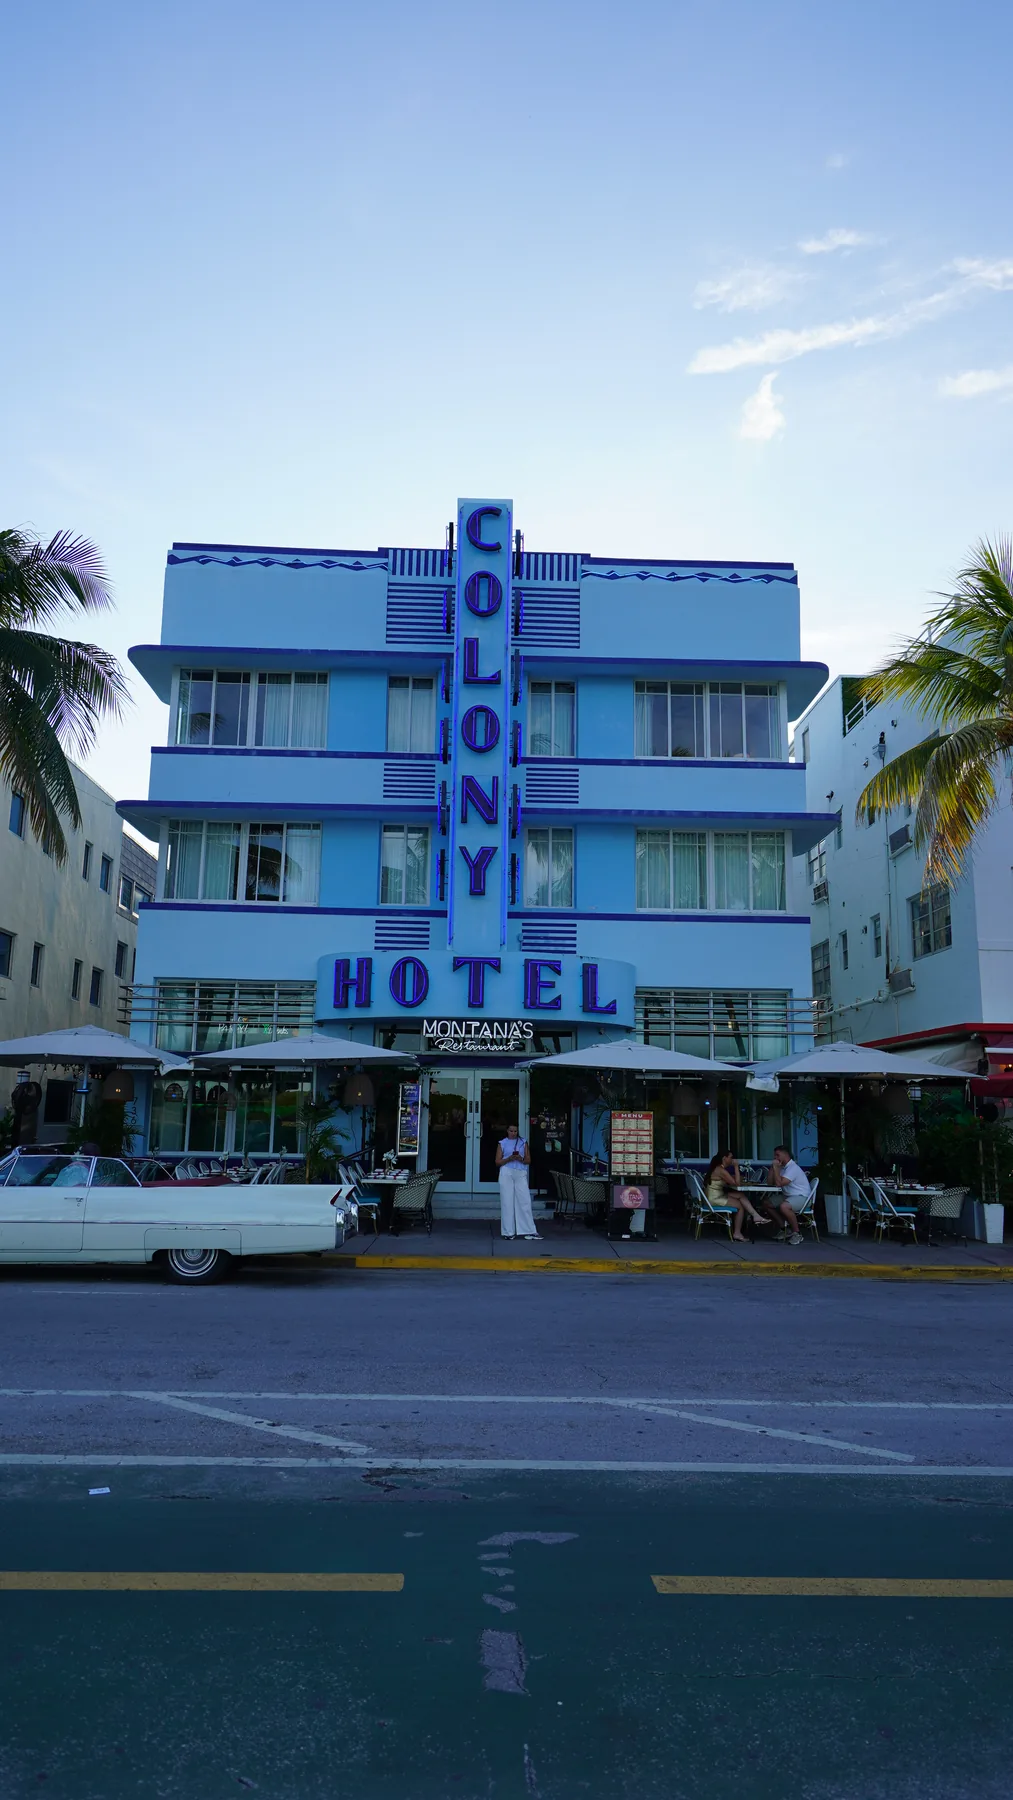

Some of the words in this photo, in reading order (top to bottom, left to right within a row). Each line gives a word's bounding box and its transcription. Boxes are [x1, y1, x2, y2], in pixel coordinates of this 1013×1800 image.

[460, 505, 502, 896] COLONY
[333, 956, 617, 1014] HOTEL
[422, 1019, 534, 1039] MONTANA'S
[434, 1037, 520, 1053] Restaurant
